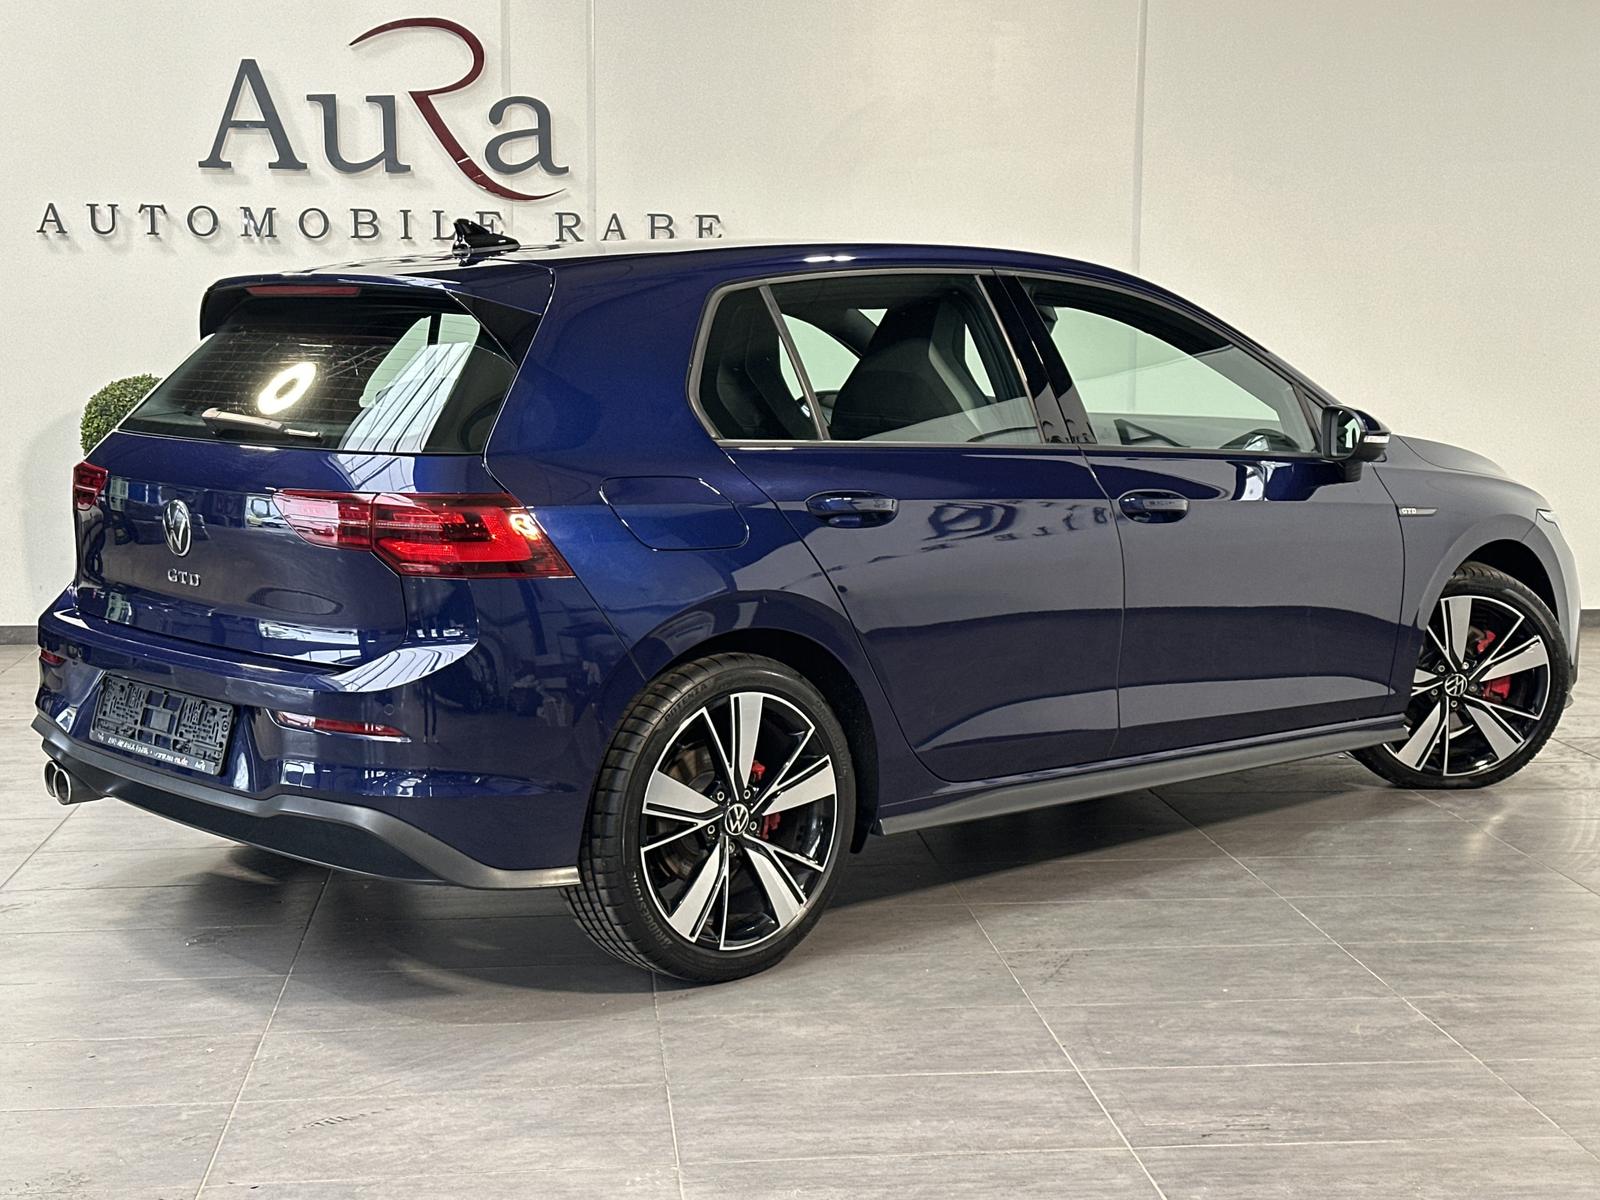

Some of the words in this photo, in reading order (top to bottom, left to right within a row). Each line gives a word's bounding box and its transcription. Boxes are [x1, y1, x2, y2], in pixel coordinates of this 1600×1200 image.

[198, 17, 570, 200] AuRa
[36, 202, 504, 241] AUTOMOBILE
[554, 211, 723, 242] RABE
[167, 568, 201, 587] GTD
